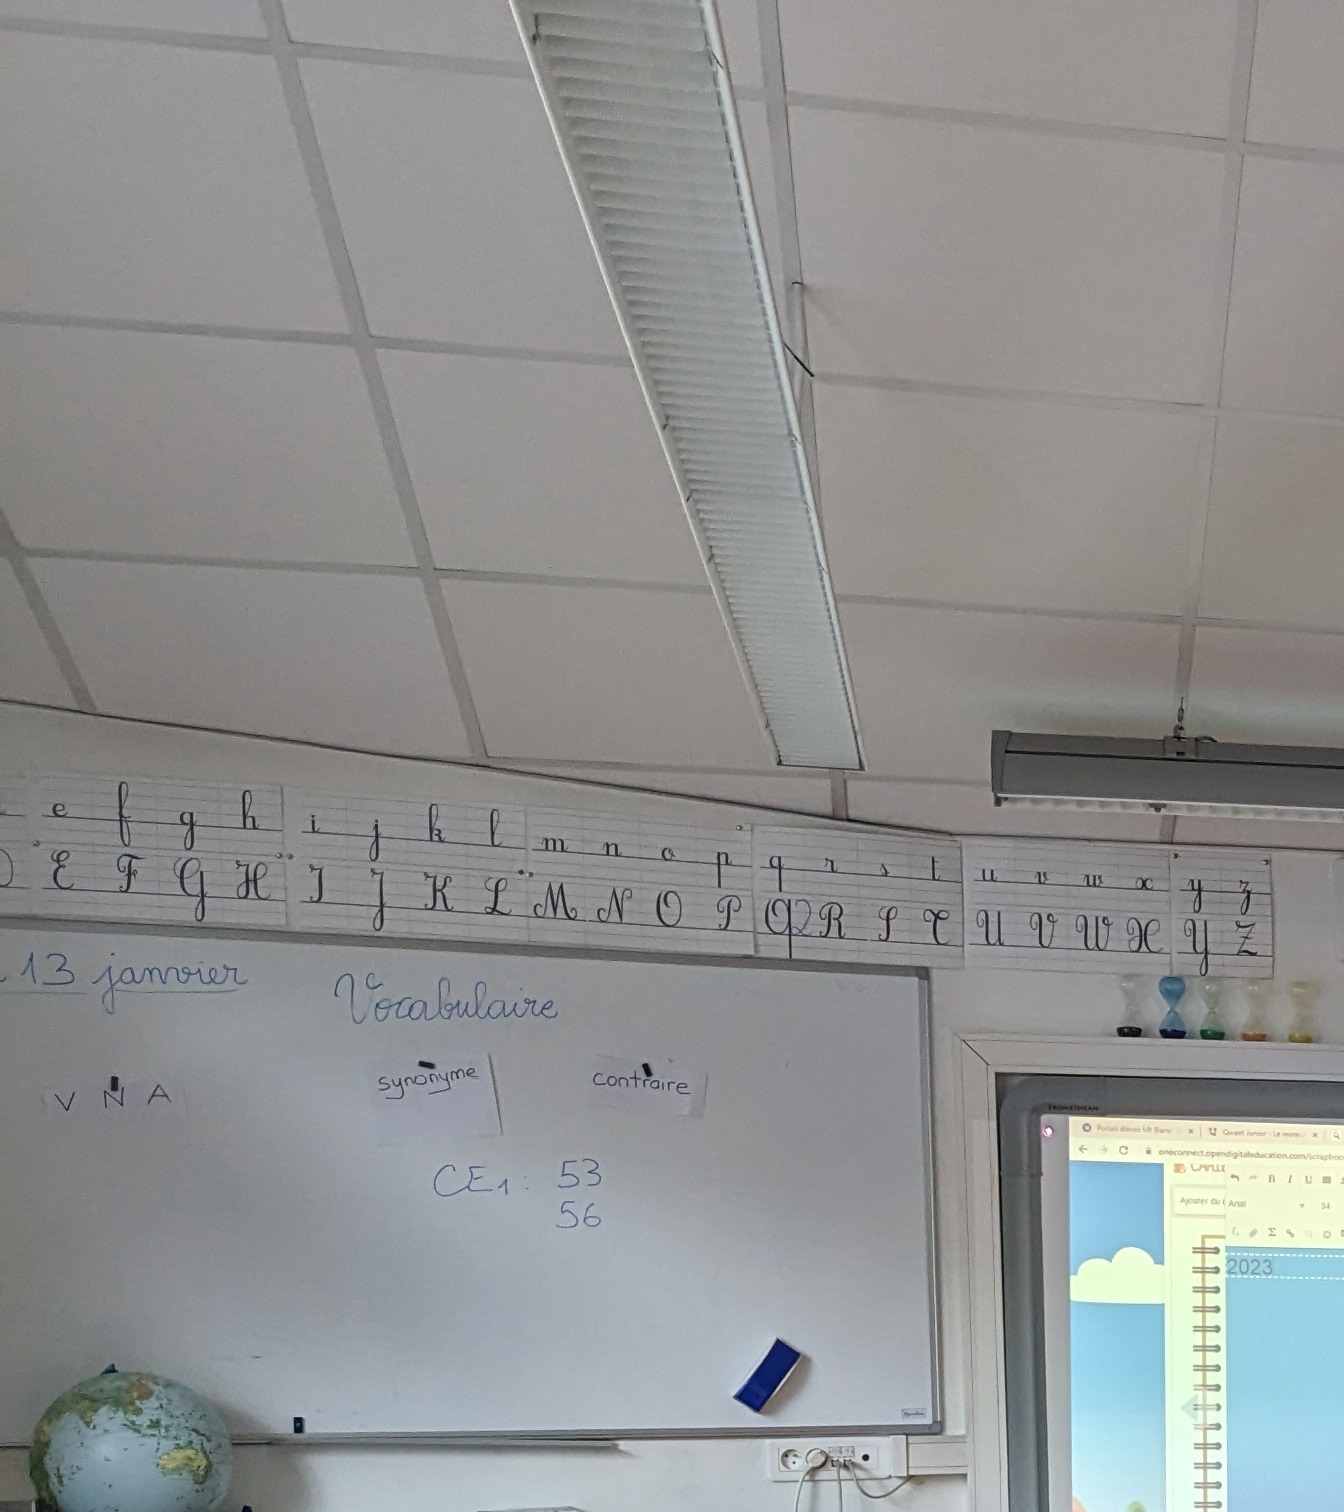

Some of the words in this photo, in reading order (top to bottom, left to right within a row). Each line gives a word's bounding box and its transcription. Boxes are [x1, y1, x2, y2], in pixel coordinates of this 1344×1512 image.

[21, 952, 77, 988] 13
[90, 957, 248, 1015] janvier
[333, 972, 559, 1026] Vocabulaire
[378, 1065, 478, 1097] synonyme
[592, 1069, 691, 1096] contraire
[558, 1159, 602, 1190] 53
[555, 1201, 602, 1231] 56
[1227, 1257, 1273, 1275] 2023
